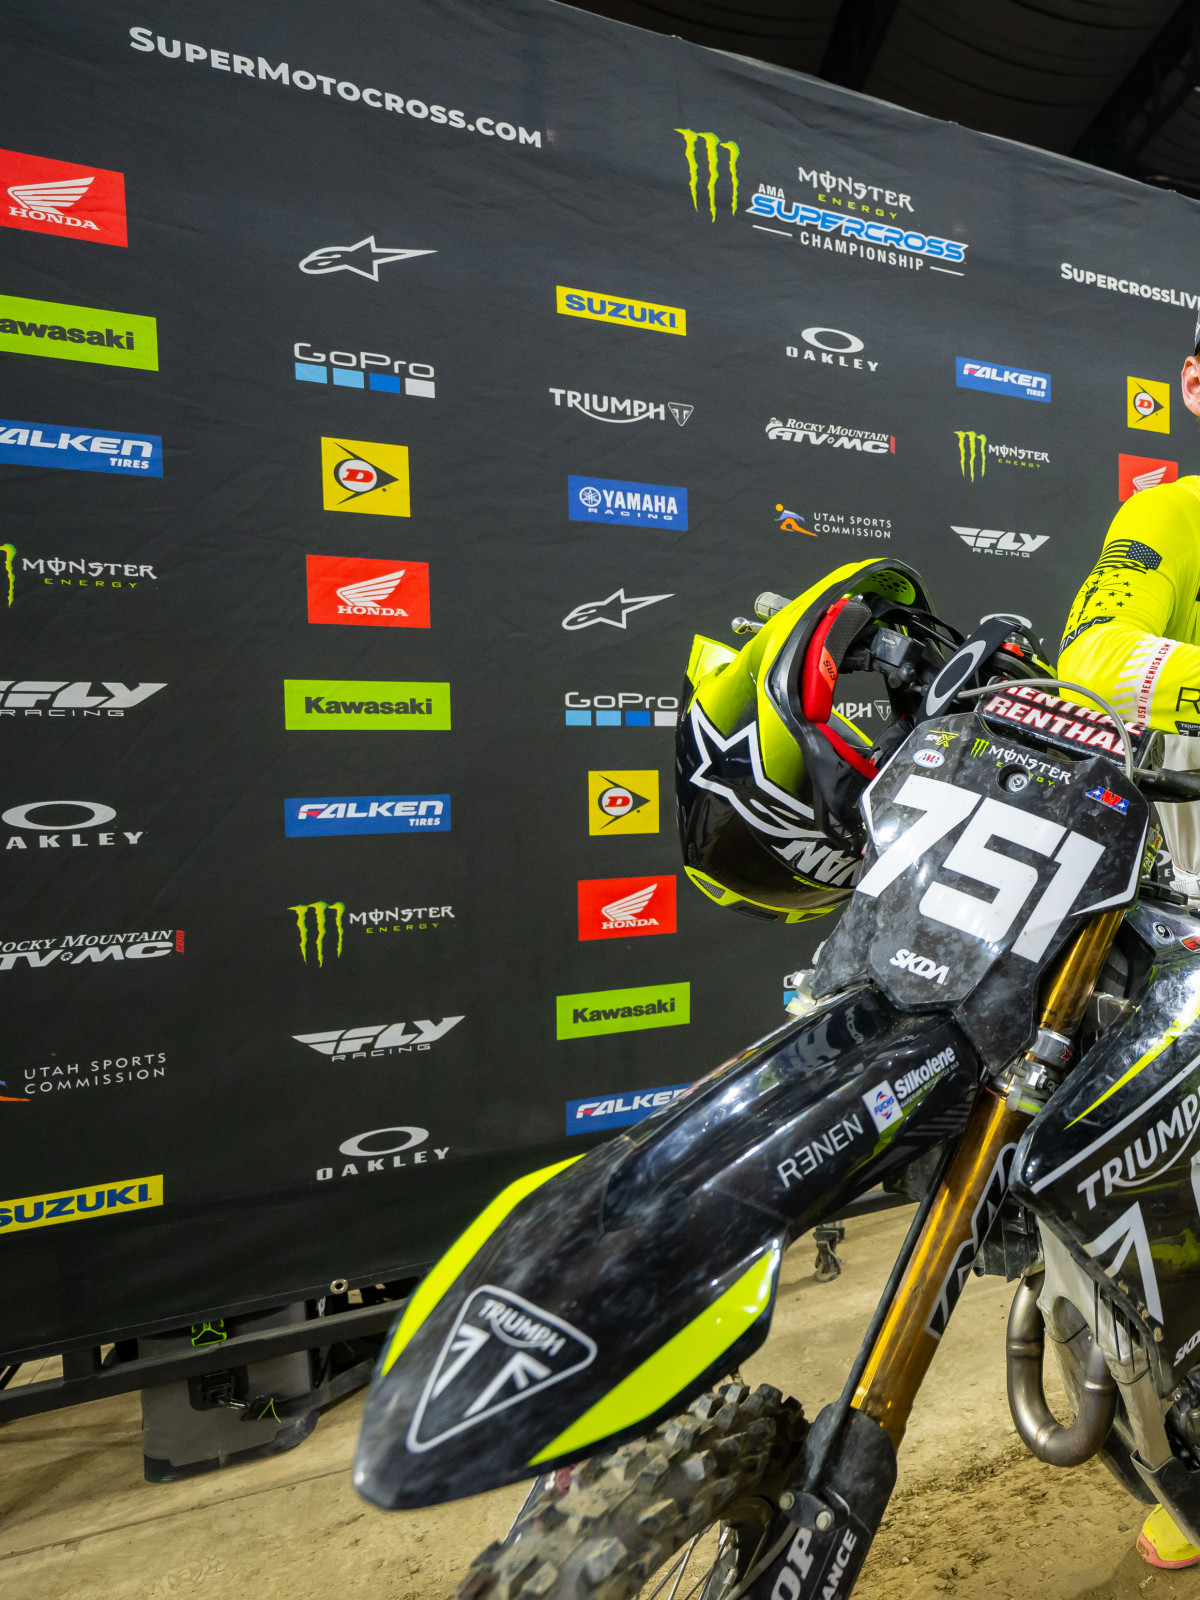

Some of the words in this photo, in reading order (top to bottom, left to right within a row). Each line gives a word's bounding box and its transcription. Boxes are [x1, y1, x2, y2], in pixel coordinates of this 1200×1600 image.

[758, 183, 785, 199] AMA
[9, 206, 100, 231] HONDA
[818, 194, 897, 219] ENERGY
[745, 192, 969, 263] SUPERCROSS
[800, 231, 924, 271] CHAMPIONSHIP
[565, 294, 677, 329] SUZUKI
[0, 318, 134, 350] awasaki
[294, 342, 435, 379] GoPro
[786, 346, 879, 372] OAKLEY
[963, 363, 1047, 390] FALKEN
[549, 387, 665, 424] TRIUMPH
[1026, 388, 1046, 398] TIRES
[0, 427, 153, 458] ALKEN
[786, 418, 825, 433] ROCKY
[827, 424, 889, 442] MOUNTAIN
[109, 457, 150, 470] TIRES
[998, 458, 1041, 469] ENERGY
[588, 508, 673, 521] RACING
[603, 489, 678, 515] YAMAHA
[814, 512, 845, 524] UTAH
[850, 515, 892, 529] SPORTS
[814, 522, 892, 540] COMMISSION
[972, 547, 1031, 558] RACING
[44, 578, 137, 589] ENERGY
[337, 605, 409, 617] HONDA
[304, 697, 433, 715] Kawasaki
[565, 692, 679, 709] GoPro
[0, 709, 124, 718] RACING
[984, 695, 1128, 757] RENTHAL
[298, 801, 444, 820] FALKEN
[409, 817, 441, 827] TIRES
[856, 774, 1106, 964] 751
[366, 922, 439, 933] ENERGY
[601, 917, 660, 930] HONDA
[61, 929, 173, 948] MOUNTAIN
[889, 949, 949, 985] SKDA
[573, 998, 676, 1025] Kawasaki
[332, 1043, 431, 1062] RACING
[24, 1063, 80, 1080] UTAH
[91, 1053, 167, 1072] SPORTS
[893, 1046, 956, 1100] Silkolene
[24, 1067, 166, 1094] COMMISSION
[873, 1095, 895, 1117] FUCHS
[316, 1147, 450, 1181] OAKLEY
[0, 1183, 152, 1228] SUZUKI
[478, 1298, 567, 1357] TRIUMPH
